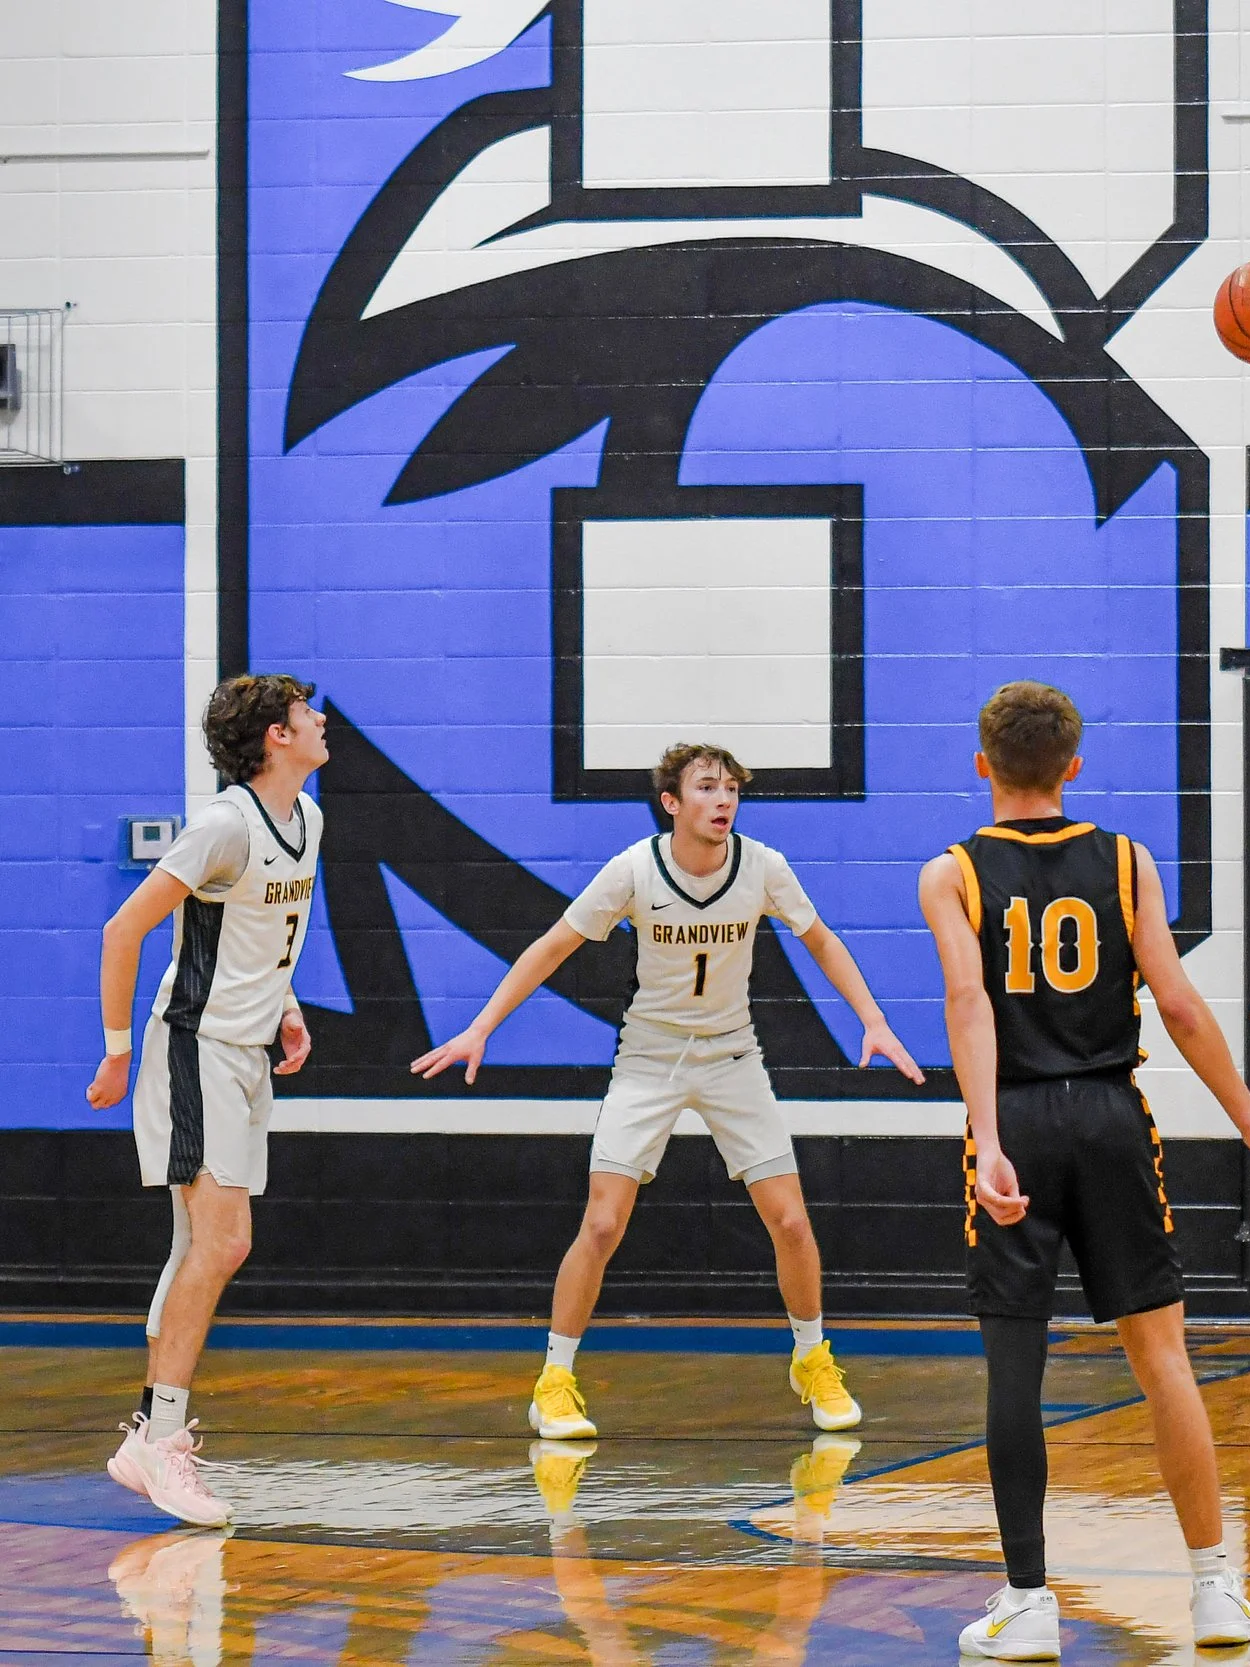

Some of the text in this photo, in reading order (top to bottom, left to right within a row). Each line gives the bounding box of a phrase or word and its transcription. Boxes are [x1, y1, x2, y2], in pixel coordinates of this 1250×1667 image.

[276, 911, 300, 969] 3
[652, 921, 750, 945] GRANDVIEW
[1003, 896, 1102, 993] 10
[693, 952, 709, 997] 1
